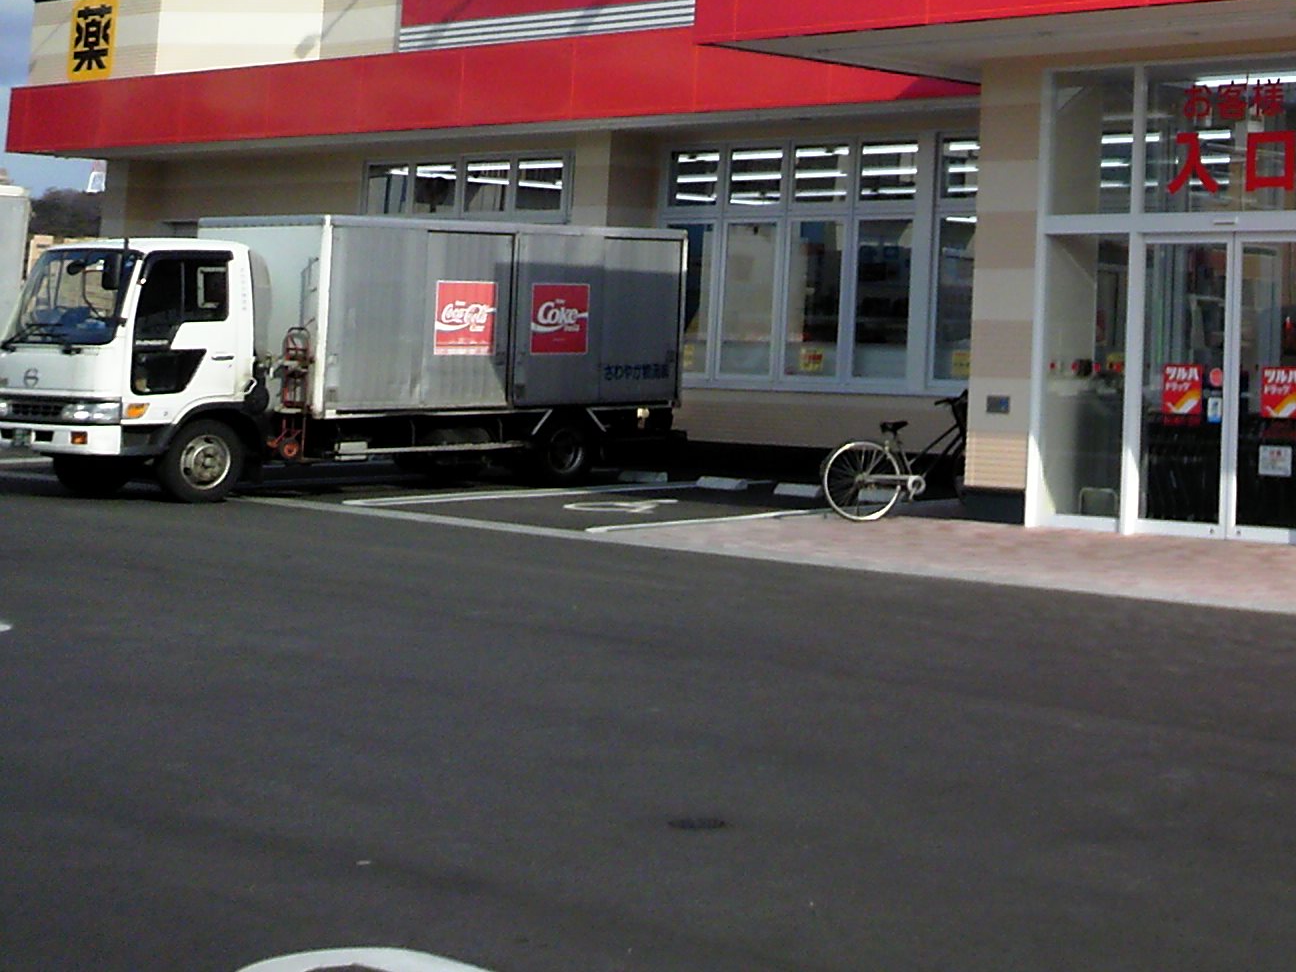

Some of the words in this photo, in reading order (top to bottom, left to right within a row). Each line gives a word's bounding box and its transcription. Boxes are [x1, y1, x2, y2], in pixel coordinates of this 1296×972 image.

[72, 4, 112, 72] 薬
[1183, 78, 1286, 120] お客様
[1166, 130, 1296, 195] 入口
[537, 302, 579, 326] Coke
[1165, 366, 1200, 381] ツルハ
